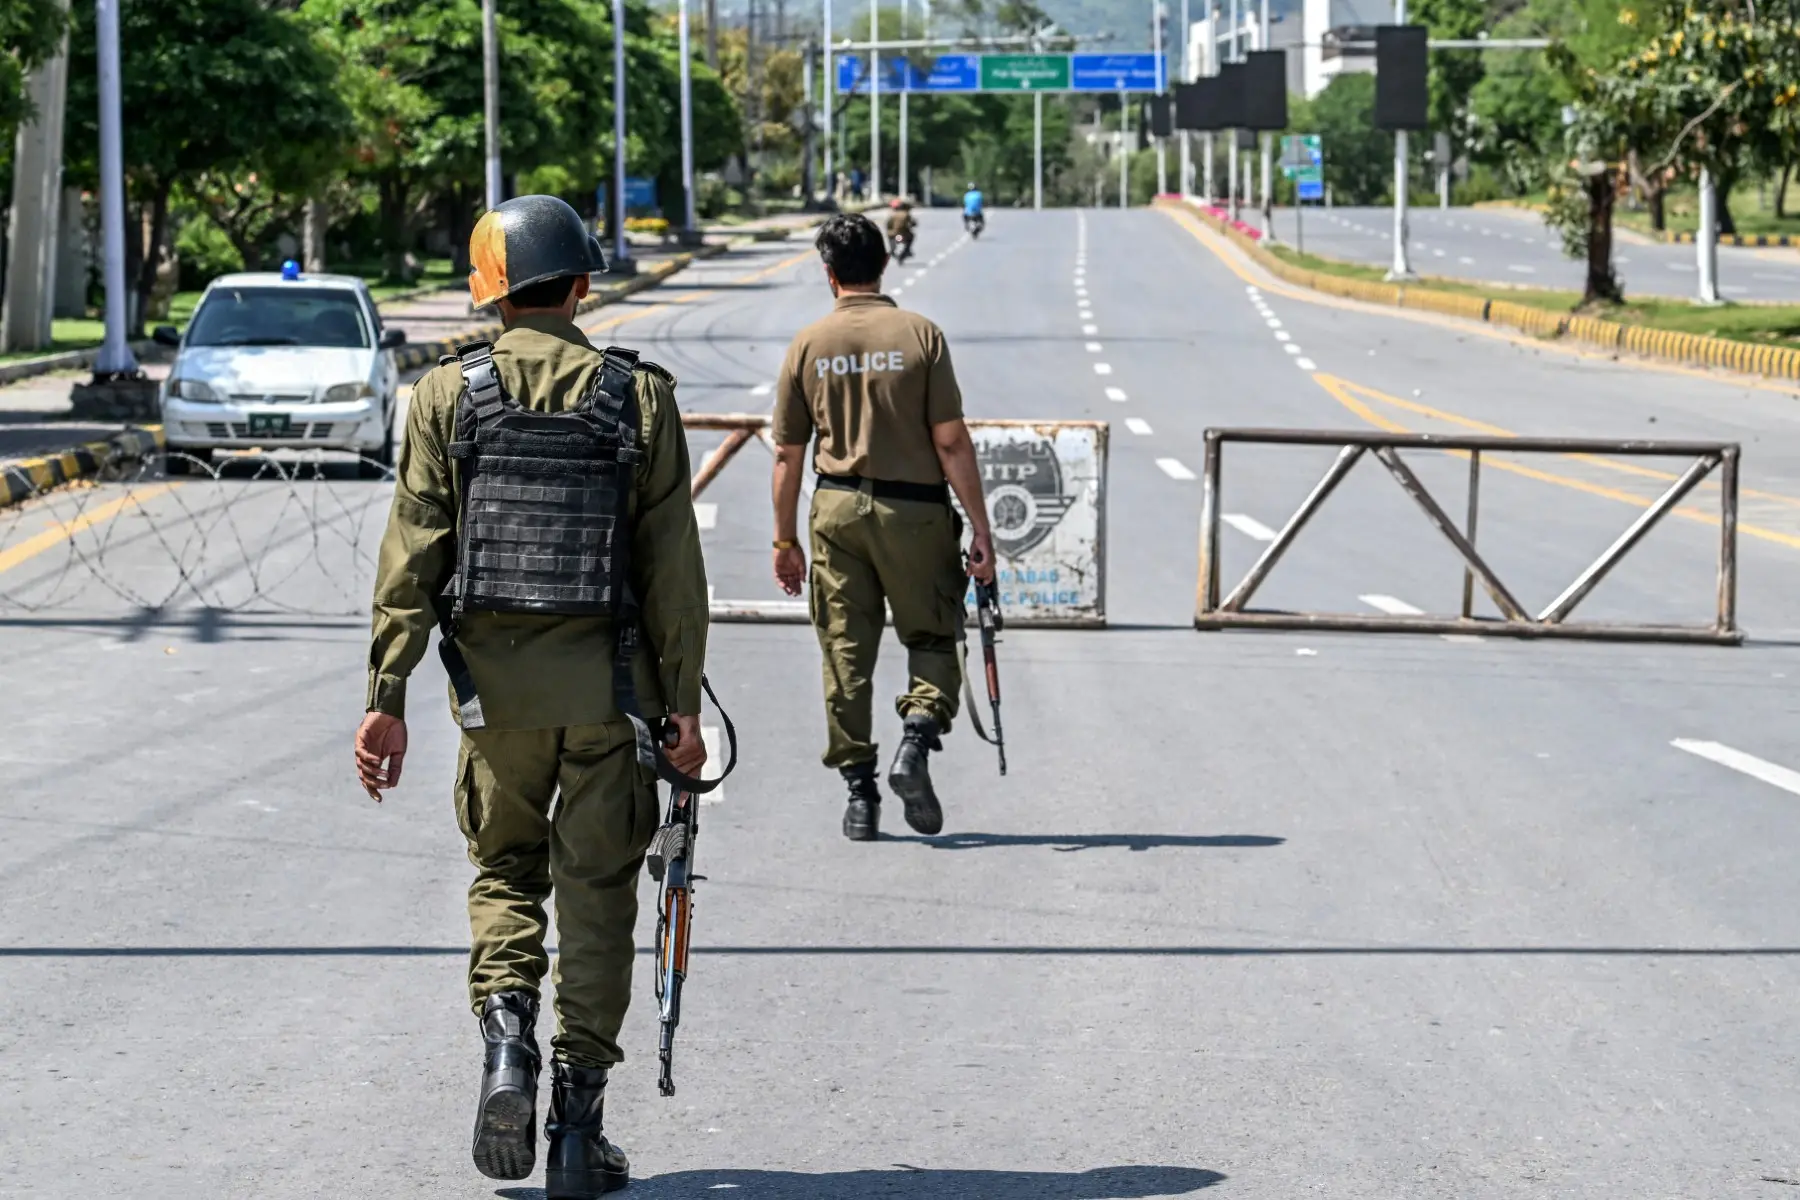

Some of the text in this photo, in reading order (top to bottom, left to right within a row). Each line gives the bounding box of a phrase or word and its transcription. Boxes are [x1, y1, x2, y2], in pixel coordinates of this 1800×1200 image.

[815, 350, 904, 378] POLICE
[983, 463, 1038, 481] ITP
[1019, 590, 1079, 605] POLICE
